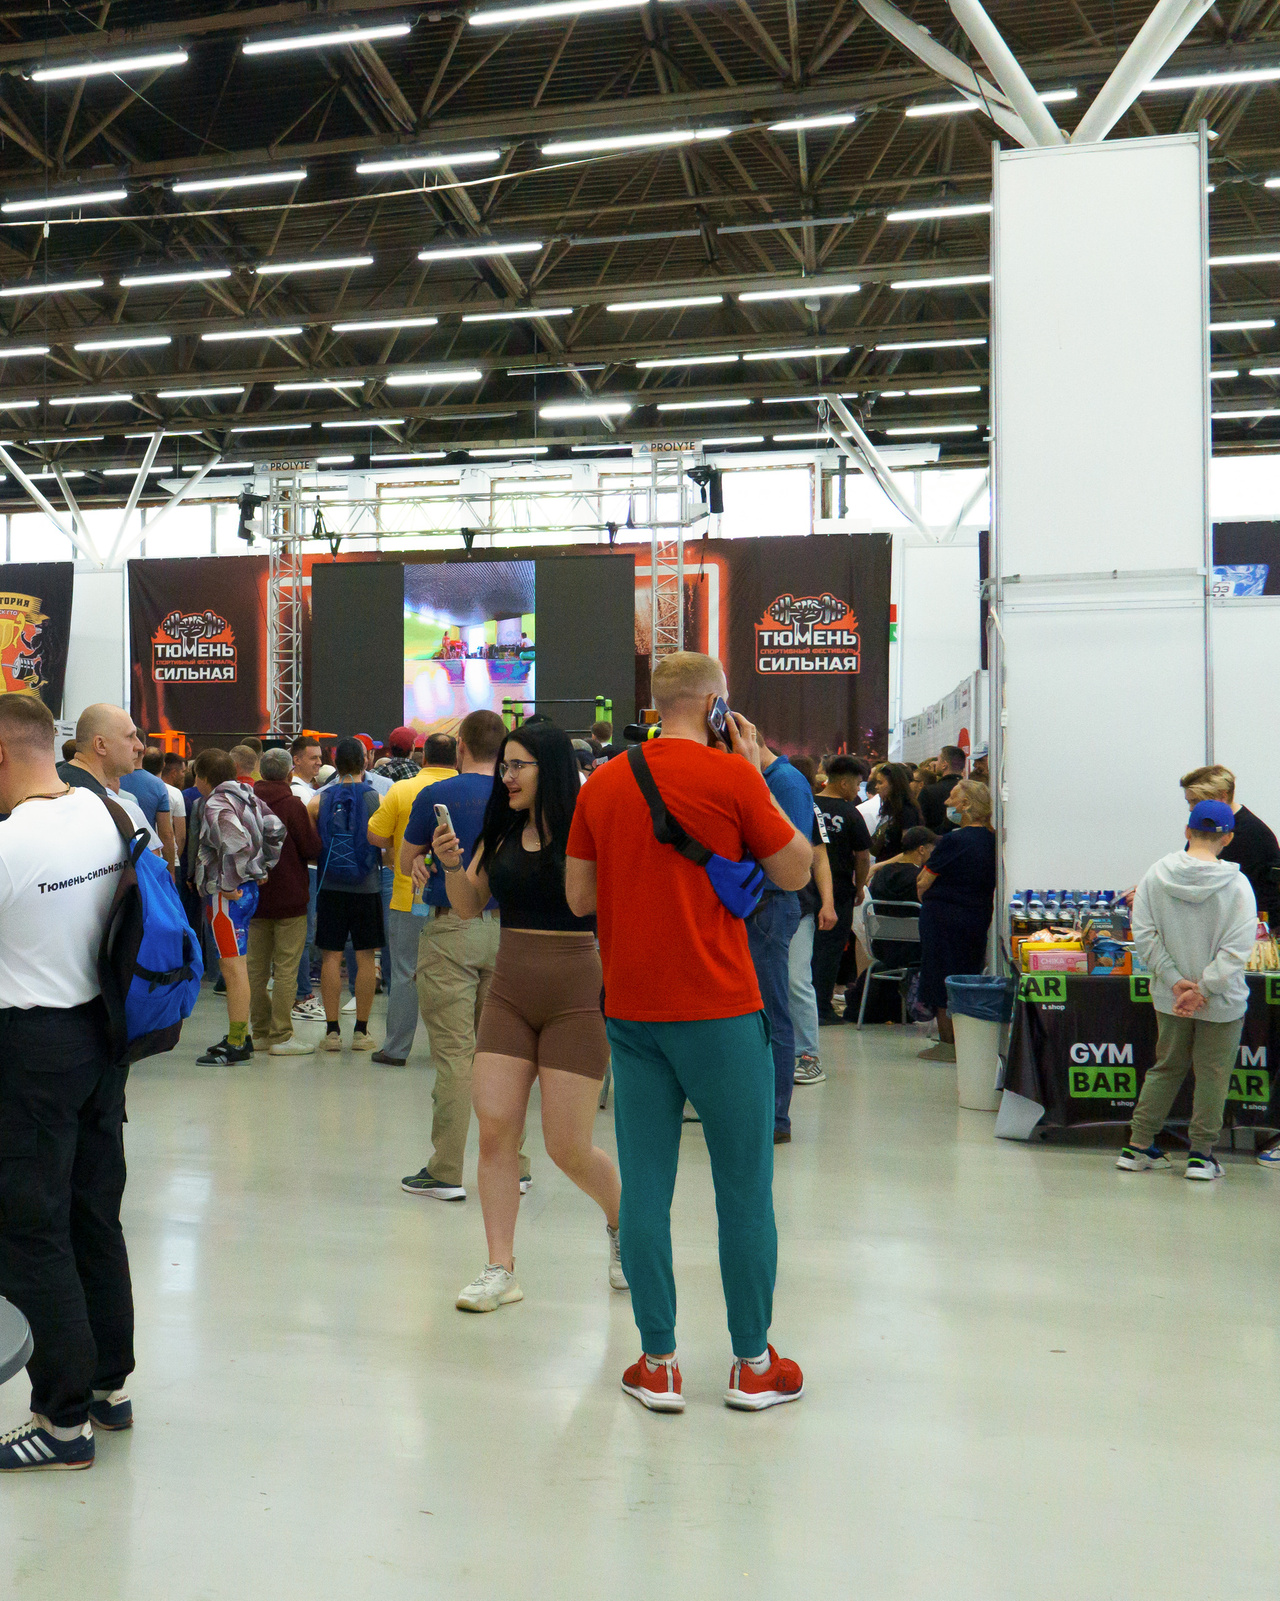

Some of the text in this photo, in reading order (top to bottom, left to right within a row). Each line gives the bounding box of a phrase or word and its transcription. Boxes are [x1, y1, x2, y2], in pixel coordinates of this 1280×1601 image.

[651, 442, 695, 452] PROLYTE
[270, 461, 310, 471] PROLYTE
[760, 630, 856, 646] ТЮМЕНЬ
[155, 643, 234, 657] ТЮМЕНЬ
[759, 656, 856, 671] СИЛЬНАЯ
[155, 667, 234, 680] СИЛЬНАЯ
[1024, 977, 1061, 997] AR
[1070, 1043, 1133, 1064] GYM
[1073, 1072, 1131, 1092] BAR
[1228, 1074, 1264, 1096] AR
